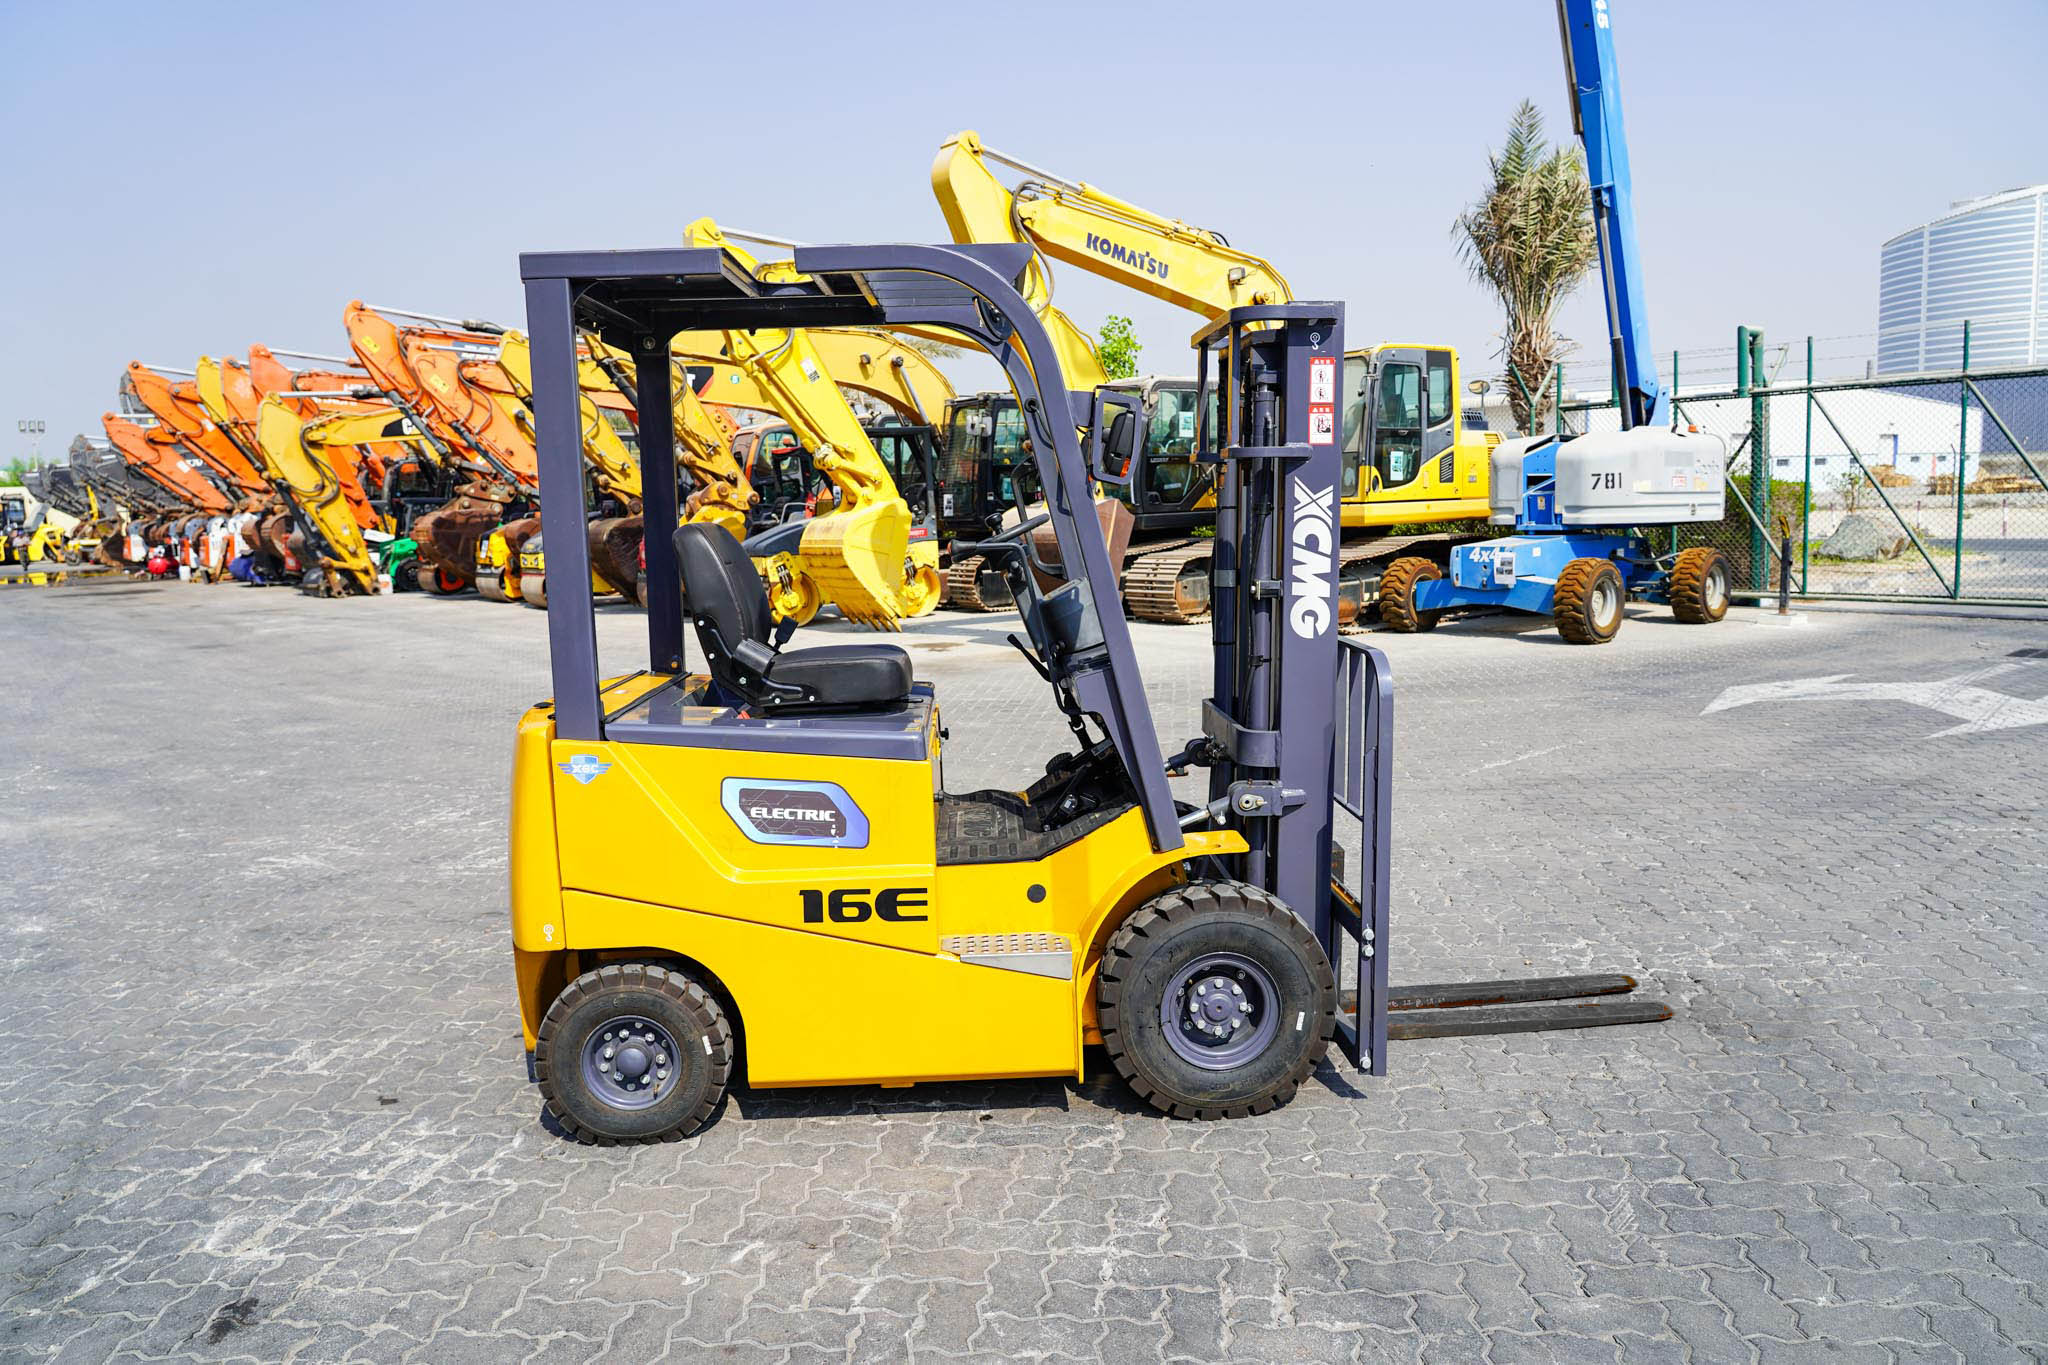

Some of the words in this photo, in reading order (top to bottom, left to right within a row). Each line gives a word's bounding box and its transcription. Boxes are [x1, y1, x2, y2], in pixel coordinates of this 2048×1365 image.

[1086, 232, 1169, 279] KOMATSU
[1591, 472, 1622, 490] 781
[1289, 475, 1334, 640] XCMG
[750, 806, 836, 822] ELECTRIC
[799, 887, 929, 924] 16E
